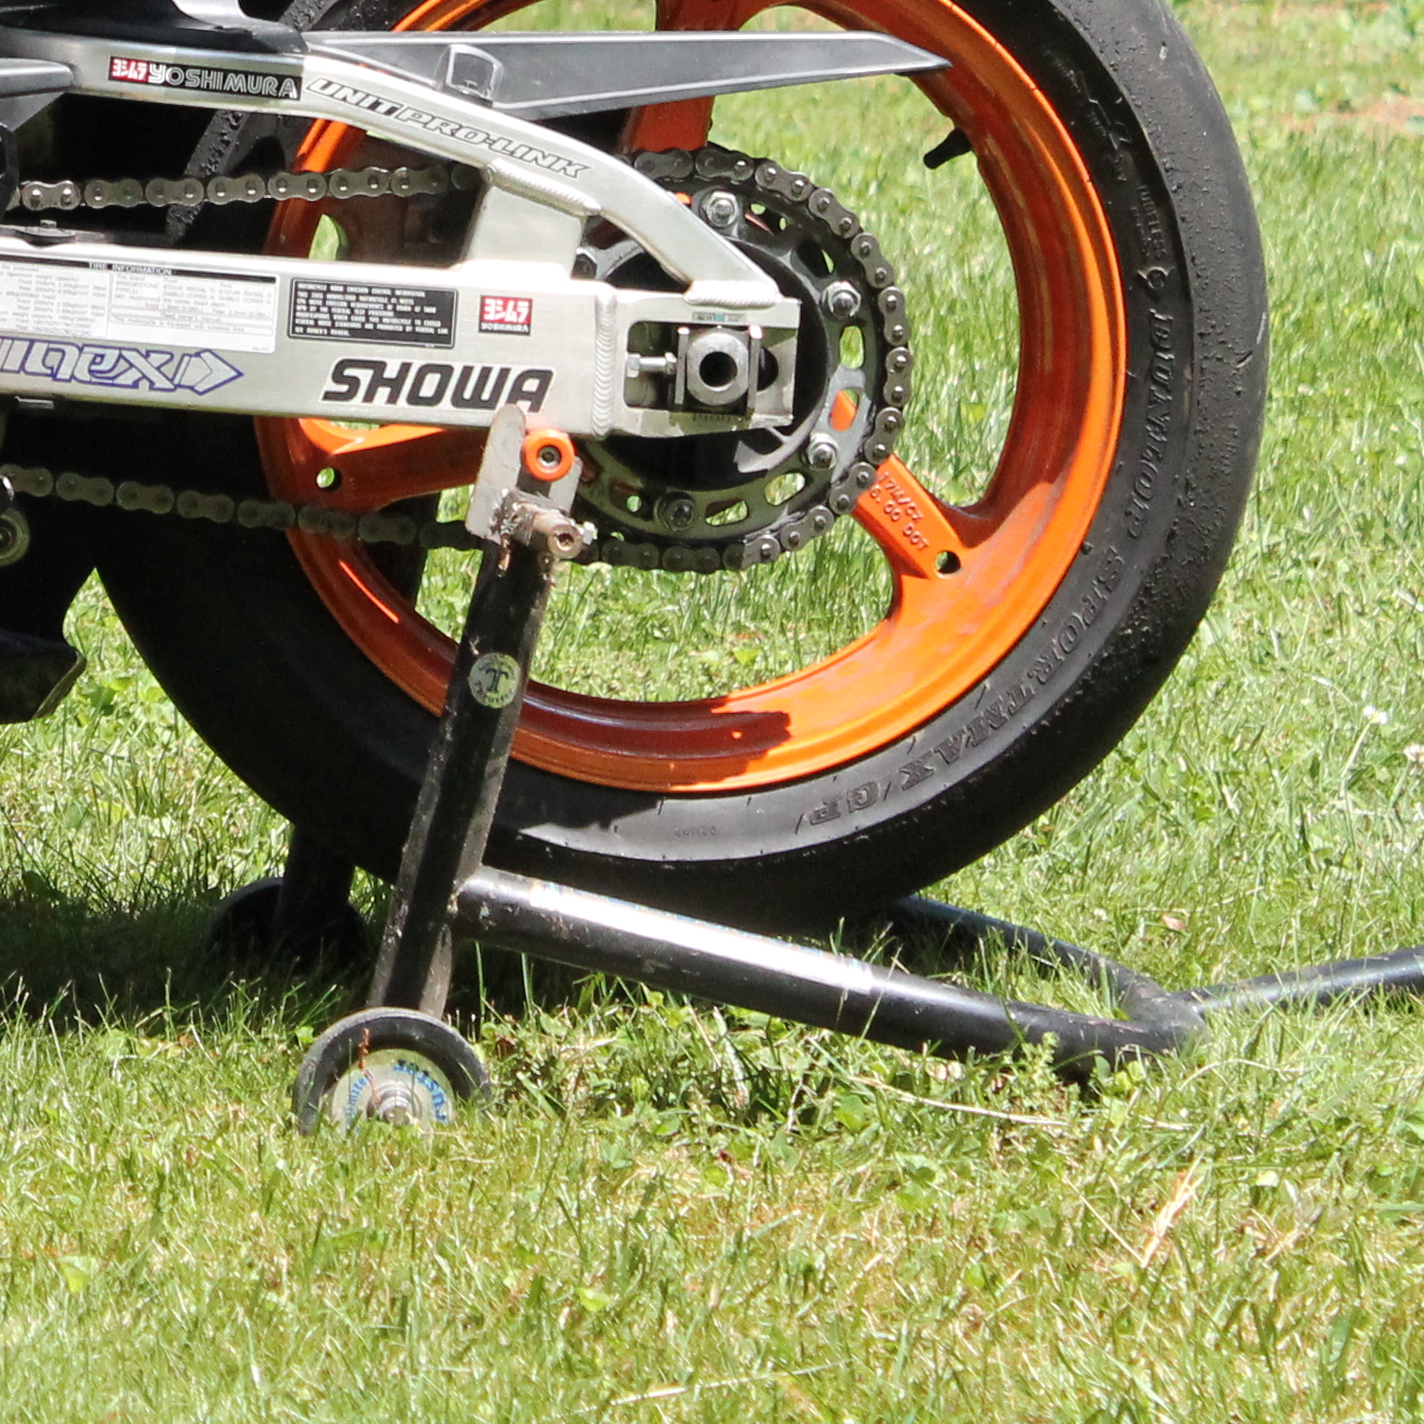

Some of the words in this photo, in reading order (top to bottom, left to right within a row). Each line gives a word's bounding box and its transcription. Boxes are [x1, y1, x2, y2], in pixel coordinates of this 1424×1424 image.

[147, 61, 299, 100] YOSHIMURA
[305, 76, 403, 121] UNIT
[395, 105, 593, 180] PRO-LINK
[111, 262, 173, 277] INFORMATION
[321, 358, 554, 414] SHOWA
[1126, 306, 1176, 543] DUNLOP
[891, 542, 1133, 798] SPORTMAX
[803, 776, 886, 829] GP
